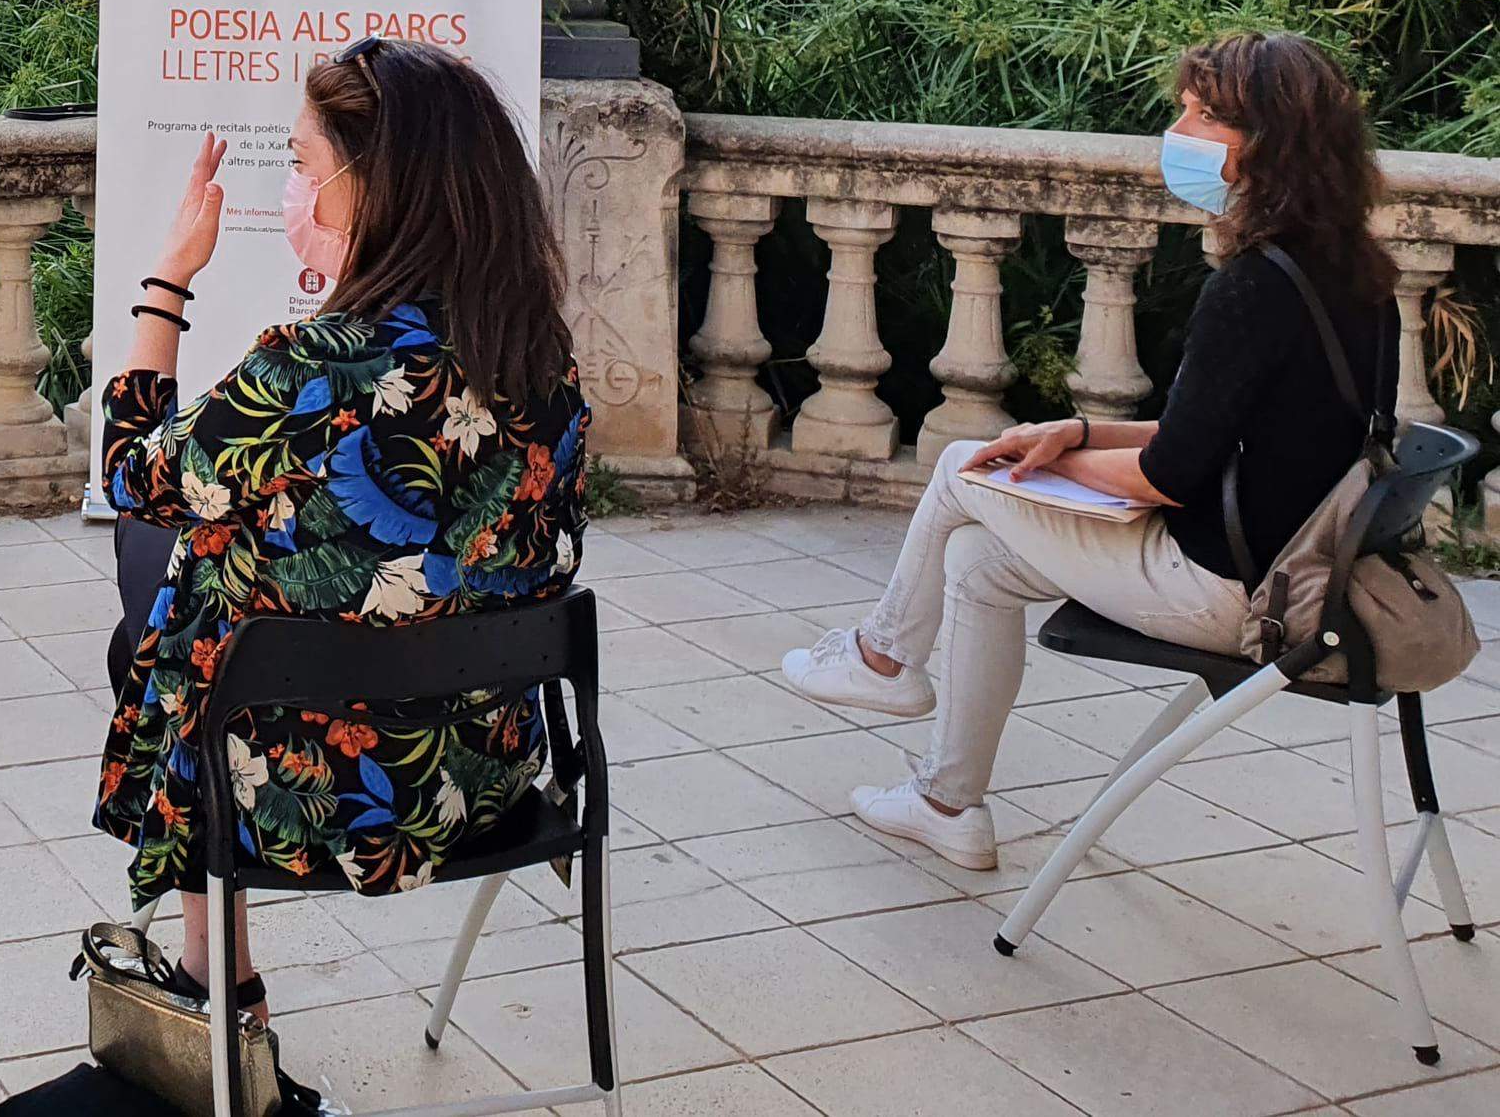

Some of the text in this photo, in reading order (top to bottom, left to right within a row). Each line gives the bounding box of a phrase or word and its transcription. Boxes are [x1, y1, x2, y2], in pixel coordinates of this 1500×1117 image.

[170, 9, 468, 45] POESIA ALS PARCS
[162, 49, 280, 82] LLETRES
[294, 52, 299, 83] I
[148, 120, 197, 133] Programa
[200, 121, 213, 131] de
[216, 123, 251, 133] recitals
[240, 139, 252, 150] de
[256, 140, 265, 150] la
[227, 156, 255, 166] altres
[258, 159, 285, 168] parcs
